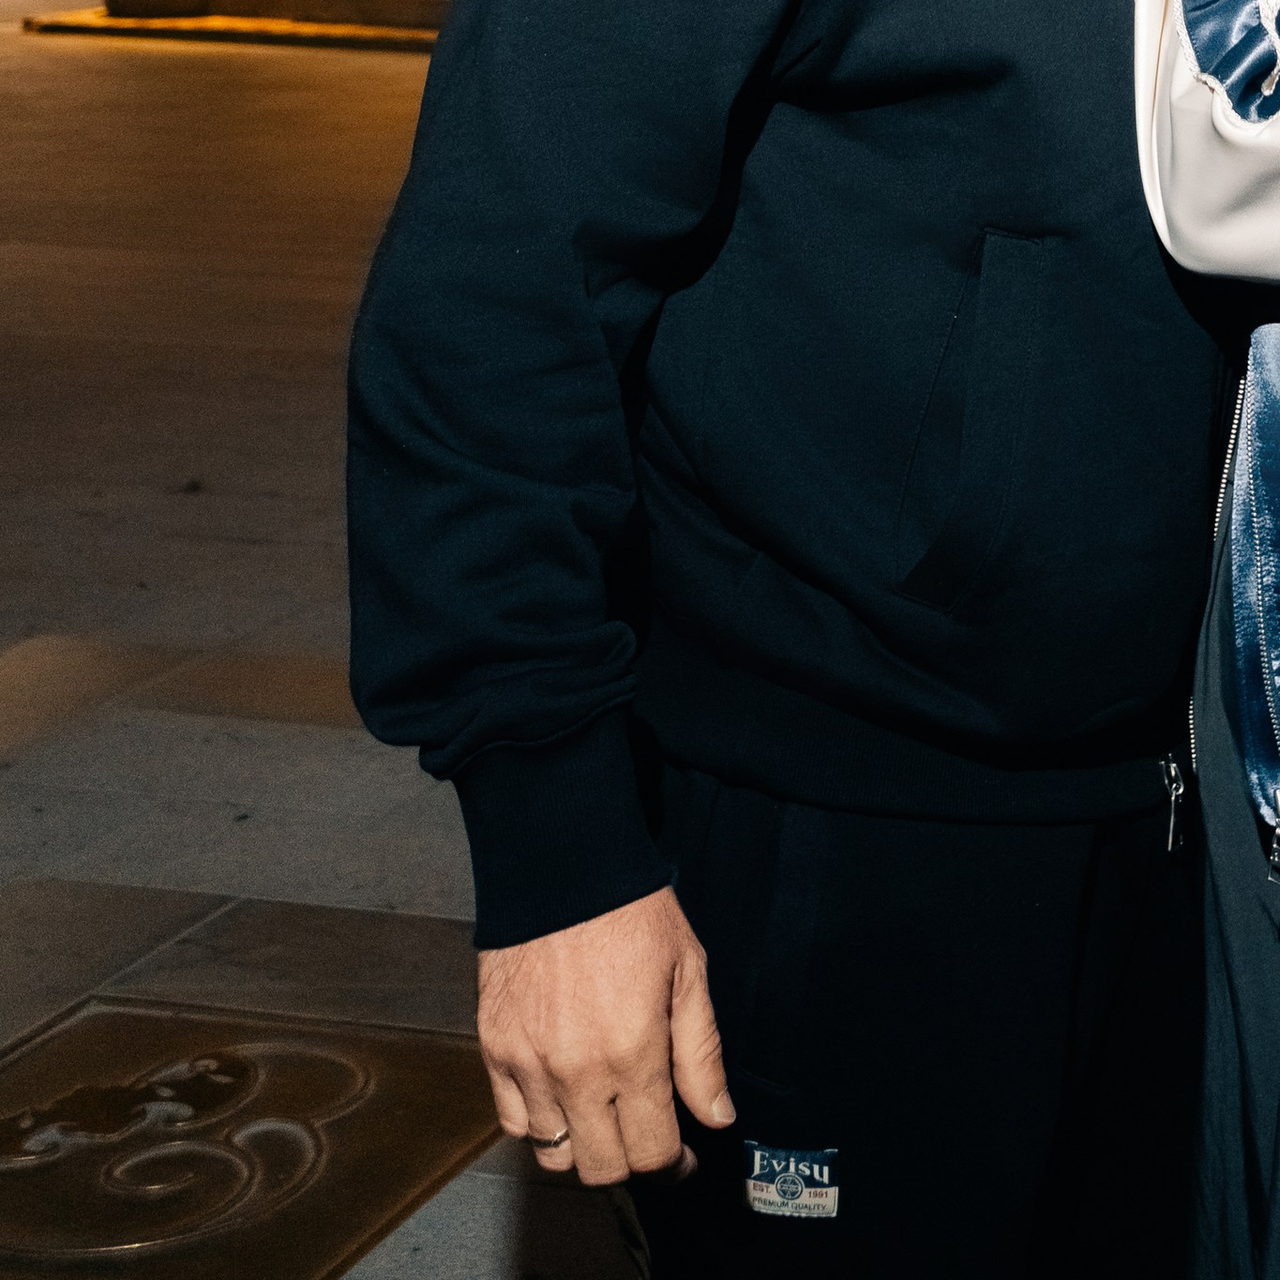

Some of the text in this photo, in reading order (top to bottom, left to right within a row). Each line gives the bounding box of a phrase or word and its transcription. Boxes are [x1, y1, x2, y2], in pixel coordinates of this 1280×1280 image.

[751, 1150, 829, 1184] Evisu
[752, 1182, 771, 1194] EST.
[752, 1196, 827, 1211] PREMIUM QUALITY
